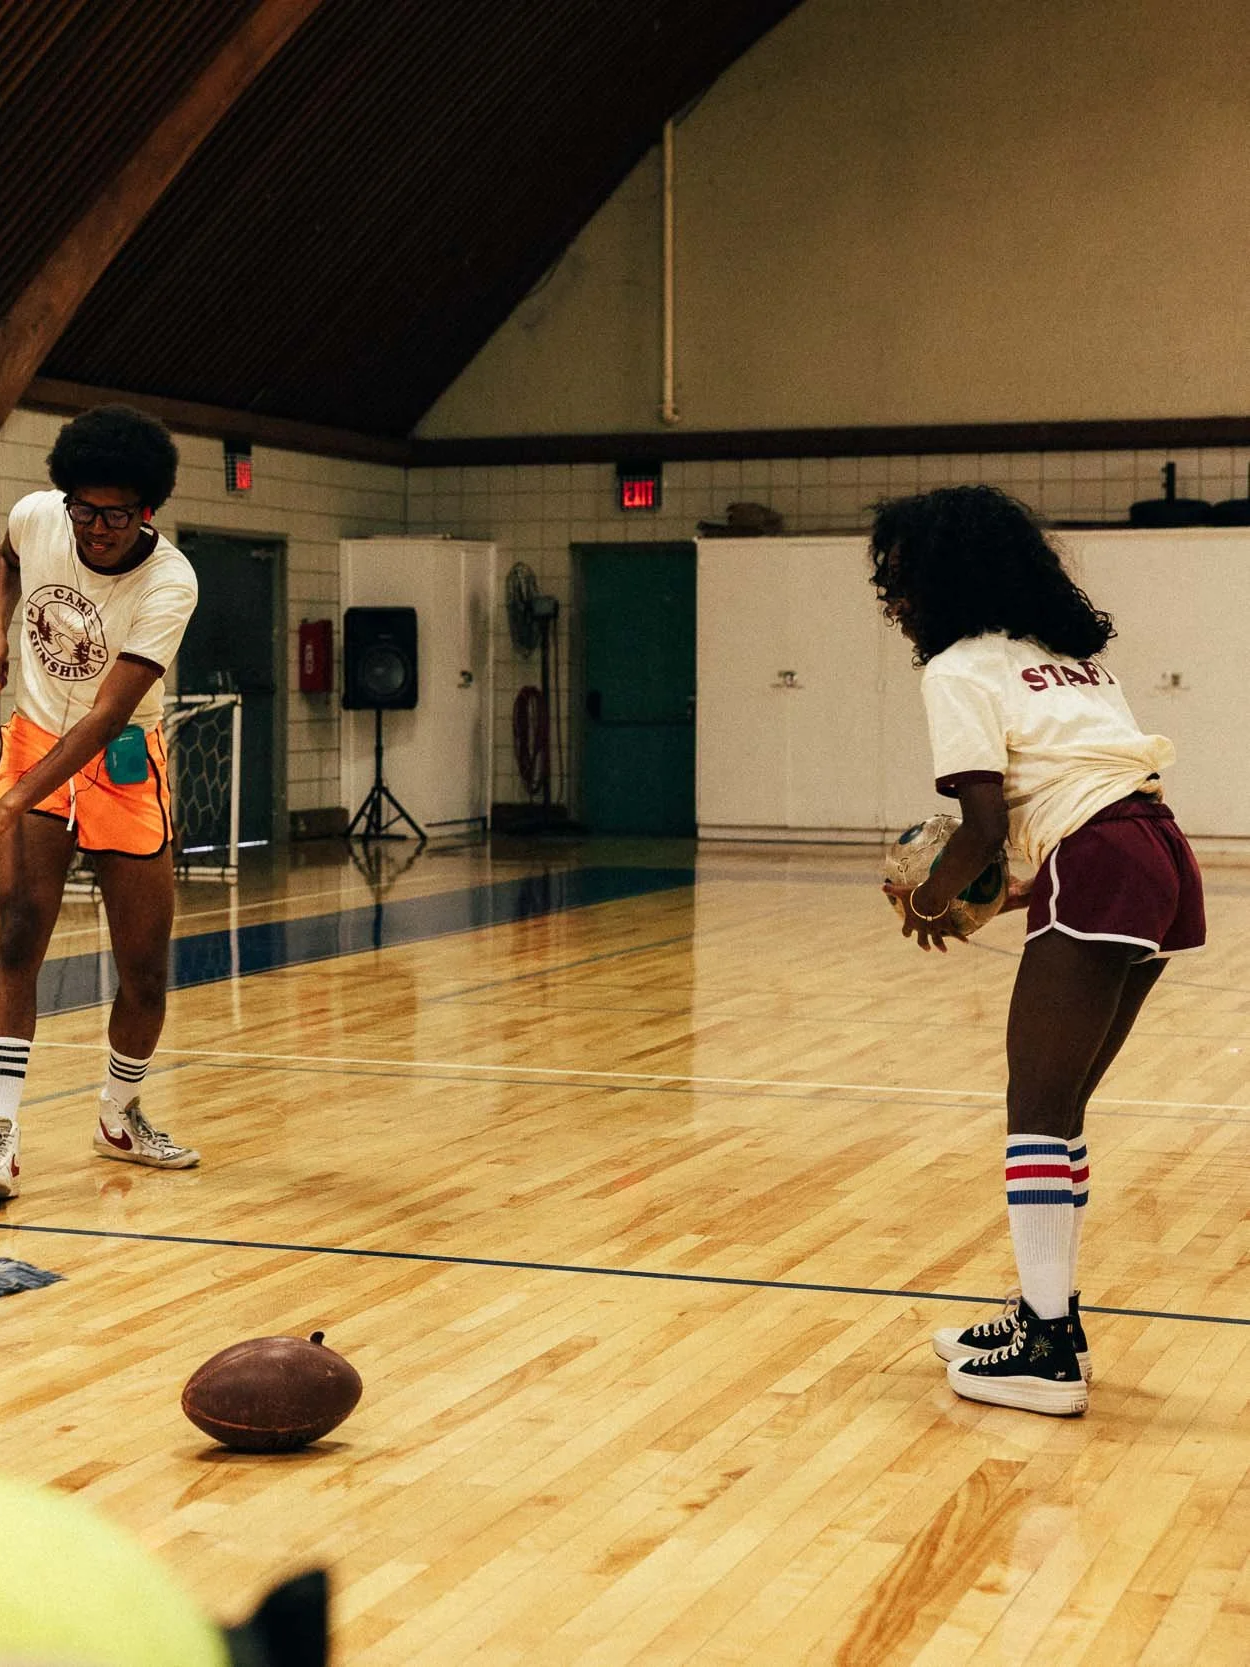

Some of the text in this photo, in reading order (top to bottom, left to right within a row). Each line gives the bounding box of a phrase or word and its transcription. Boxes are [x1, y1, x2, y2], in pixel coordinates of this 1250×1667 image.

[623, 480, 654, 507] EXIT
[53, 588, 93, 617] CAMP
[28, 629, 97, 678] SUNSHINE
